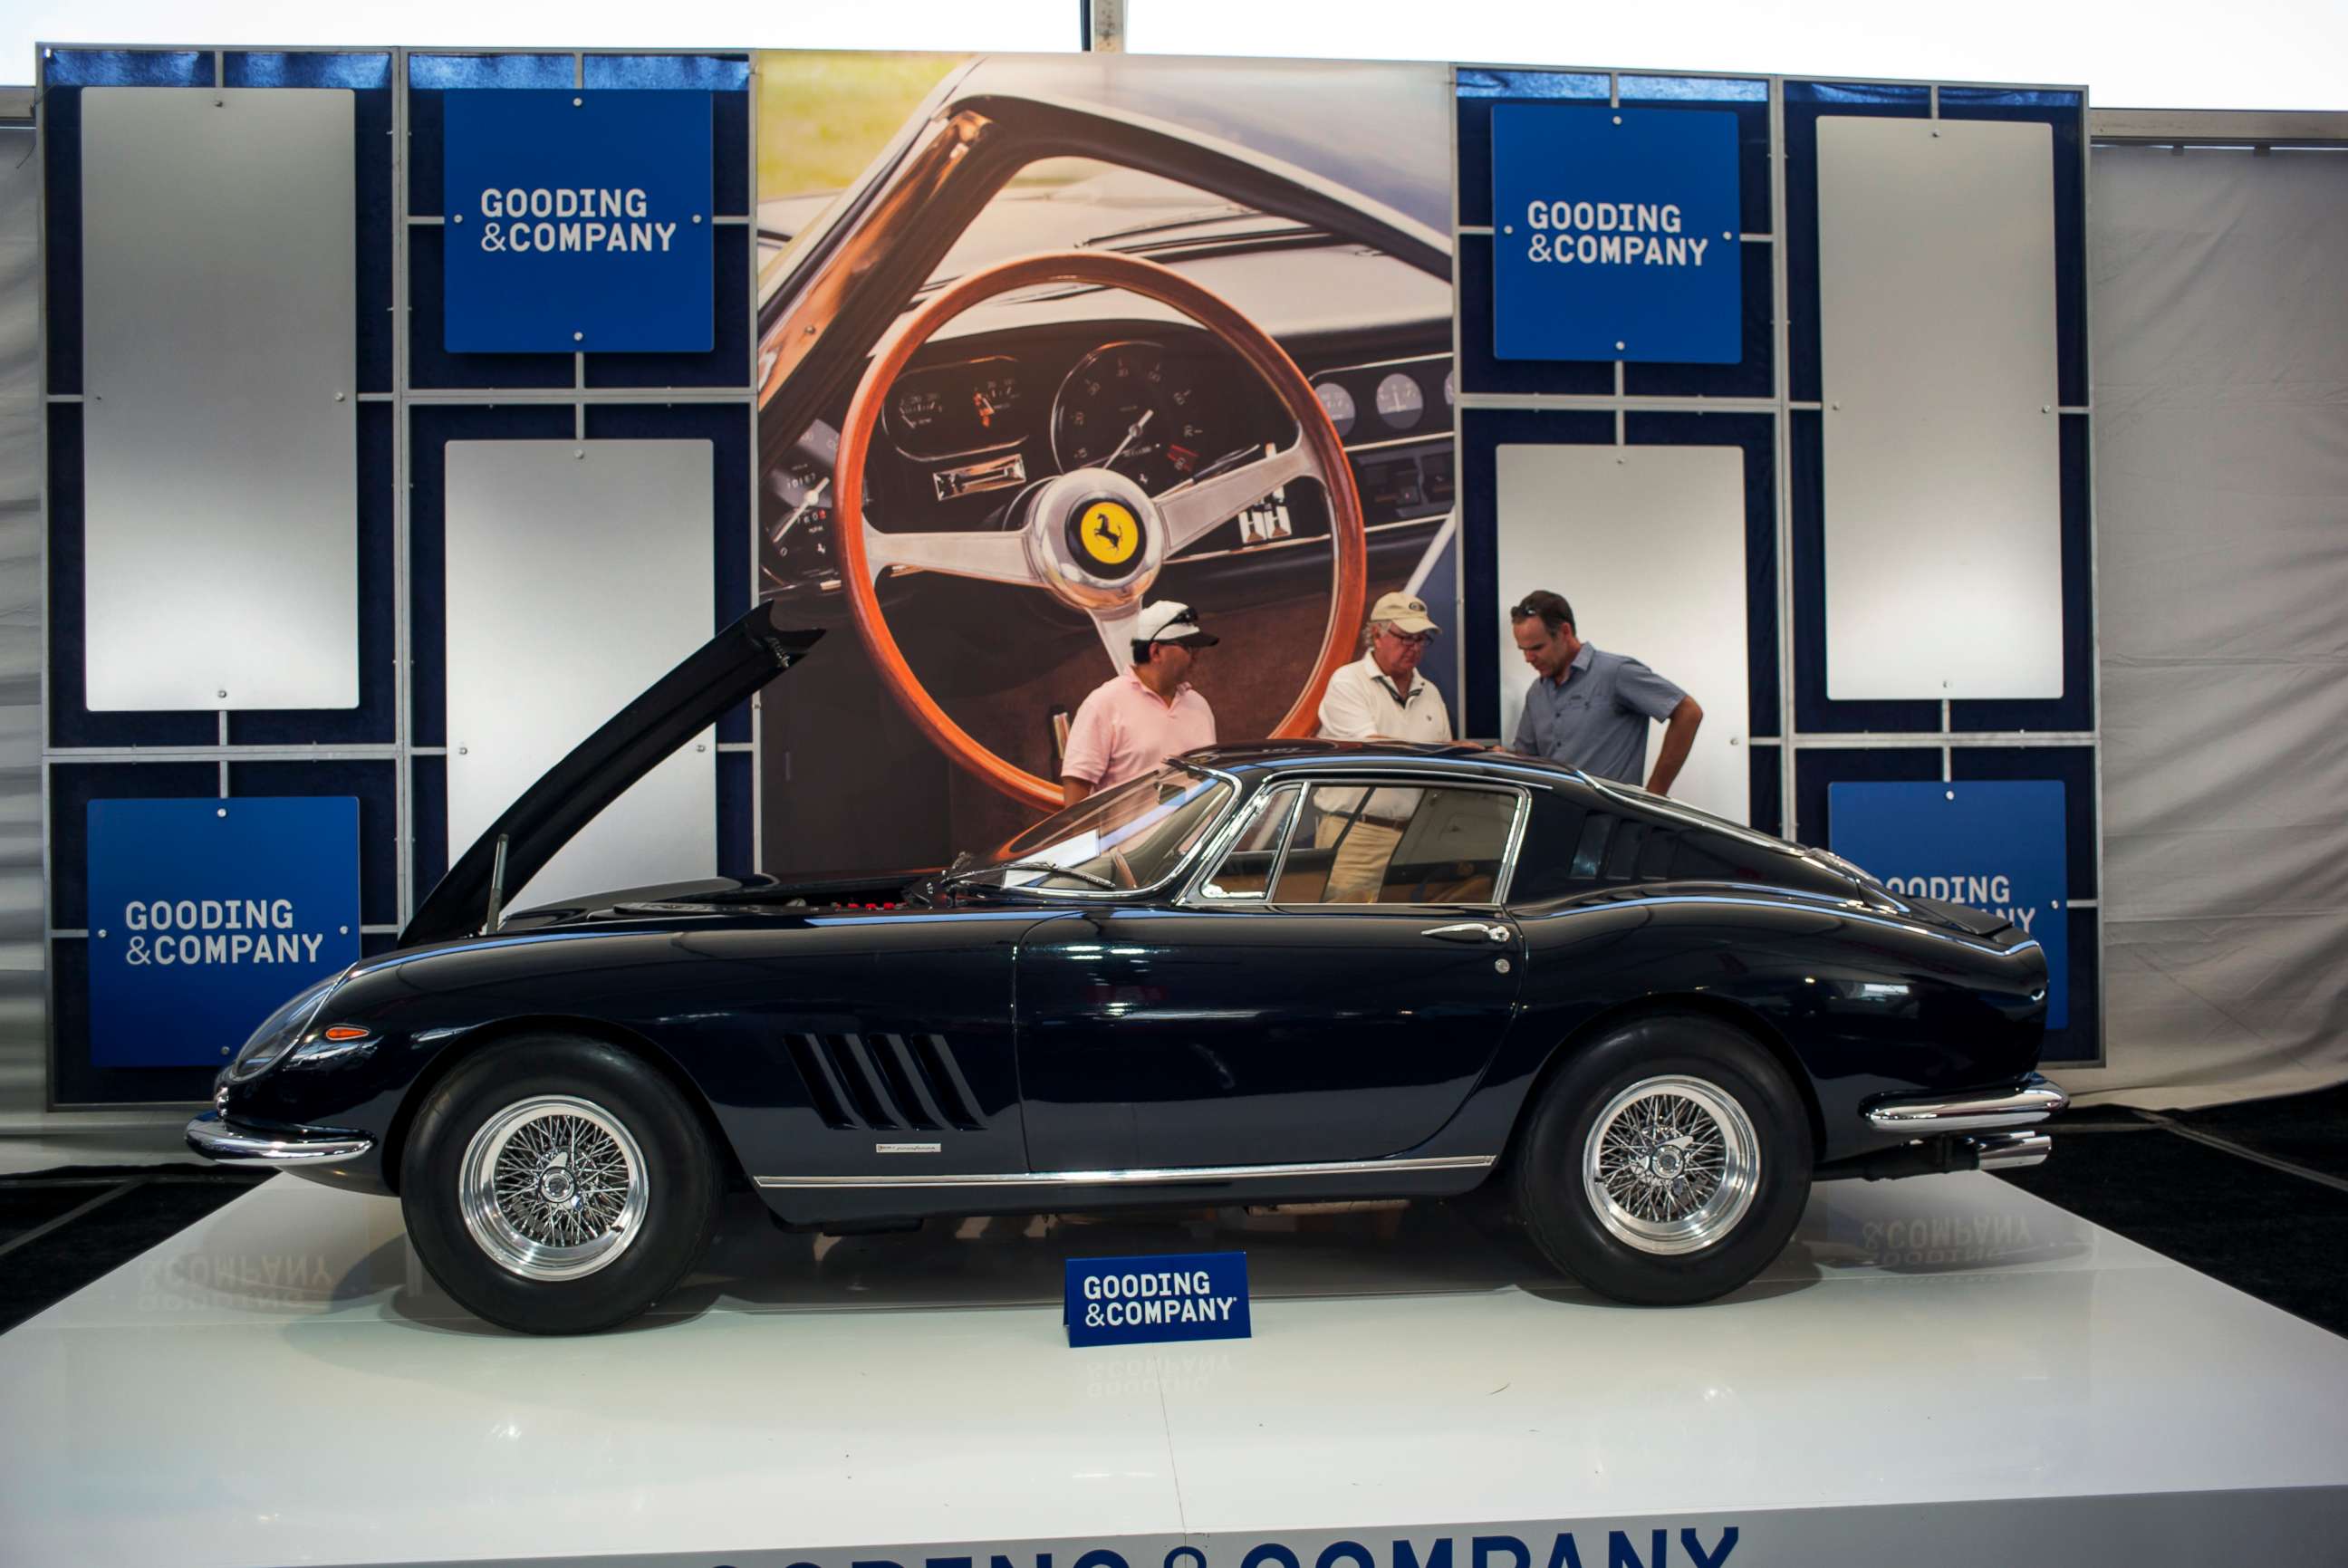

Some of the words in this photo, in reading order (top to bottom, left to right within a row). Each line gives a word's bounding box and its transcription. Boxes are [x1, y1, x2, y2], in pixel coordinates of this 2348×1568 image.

[482, 188, 646, 217] GOODING
[1528, 201, 1680, 233] GOODING
[482, 223, 676, 252] &COMPANY
[1528, 234, 1708, 265] &COMPANY
[1874, 875, 2009, 904] OODING
[126, 899, 293, 929] GOODING
[127, 934, 322, 965] &COMPANY
[1084, 1272, 1209, 1299] GOODING
[1085, 1297, 1233, 1326] &COMPANY
